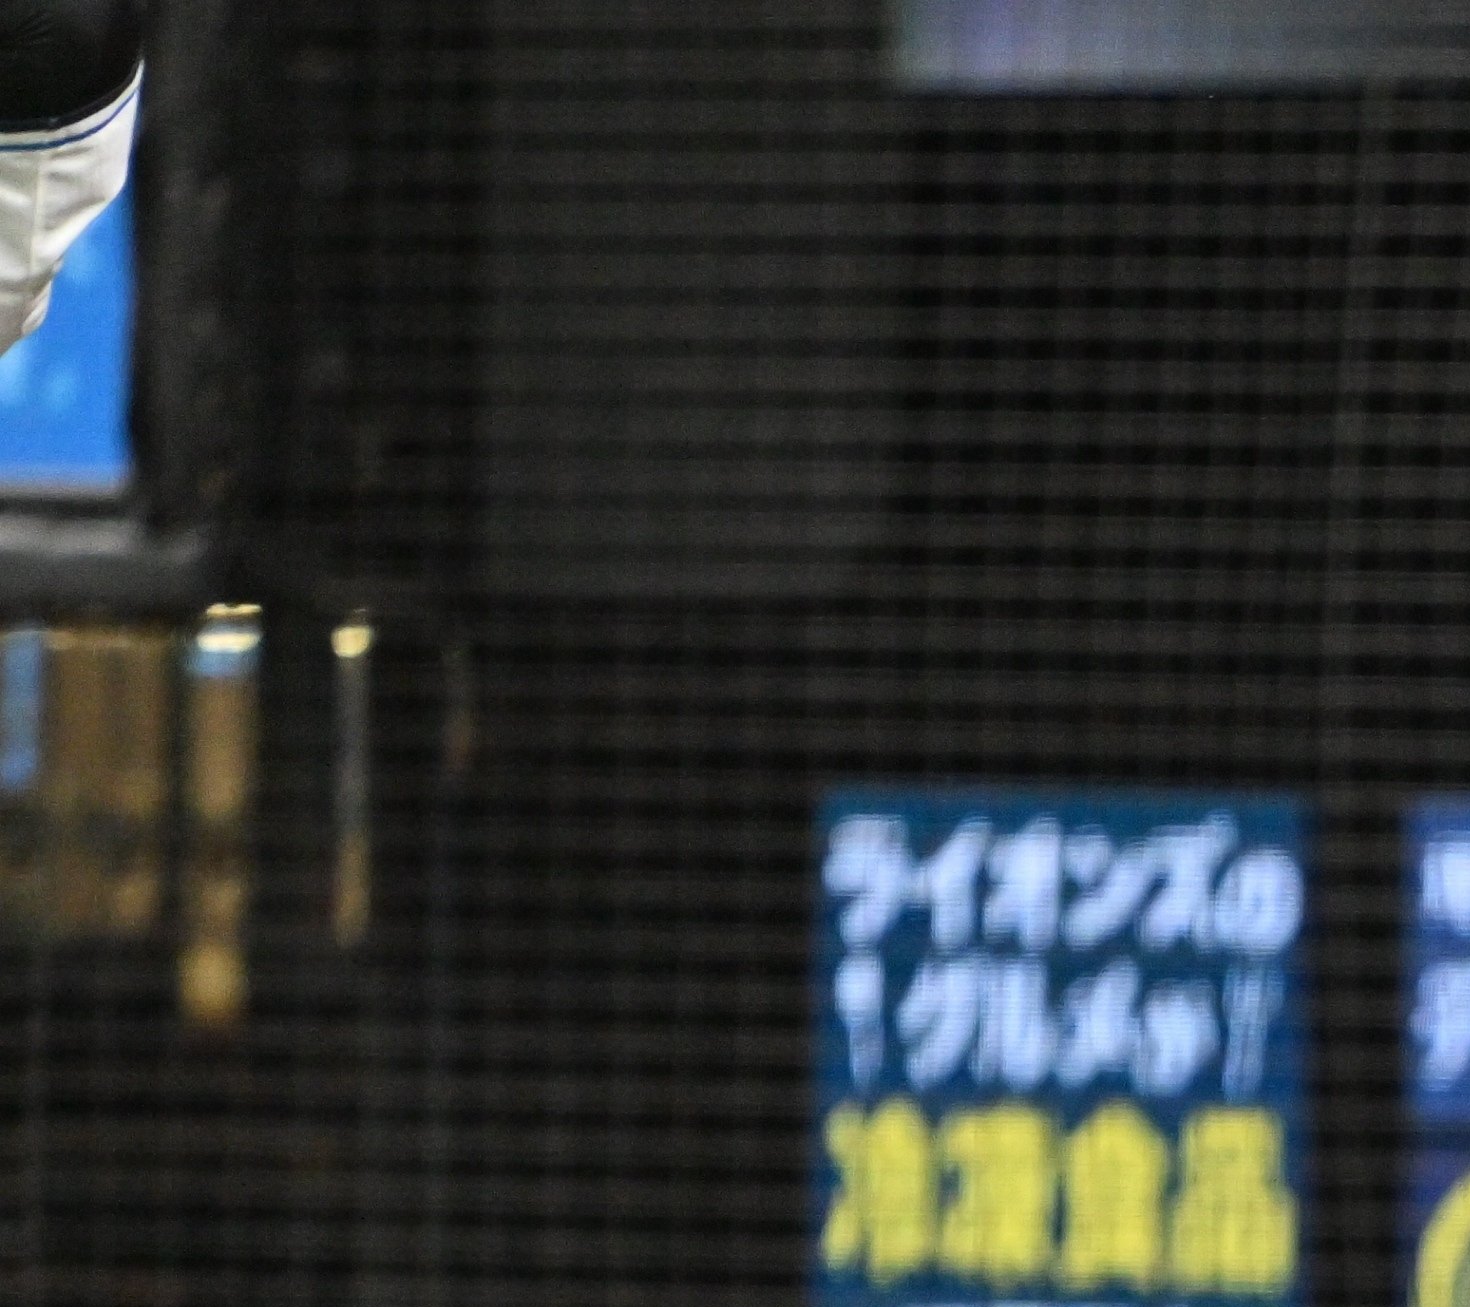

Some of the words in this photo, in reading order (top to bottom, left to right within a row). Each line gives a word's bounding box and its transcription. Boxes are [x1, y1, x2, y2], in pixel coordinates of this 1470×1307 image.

[822, 812, 1302, 955] ライオンズの
[820, 1096, 1296, 1292] 冷凍食品
